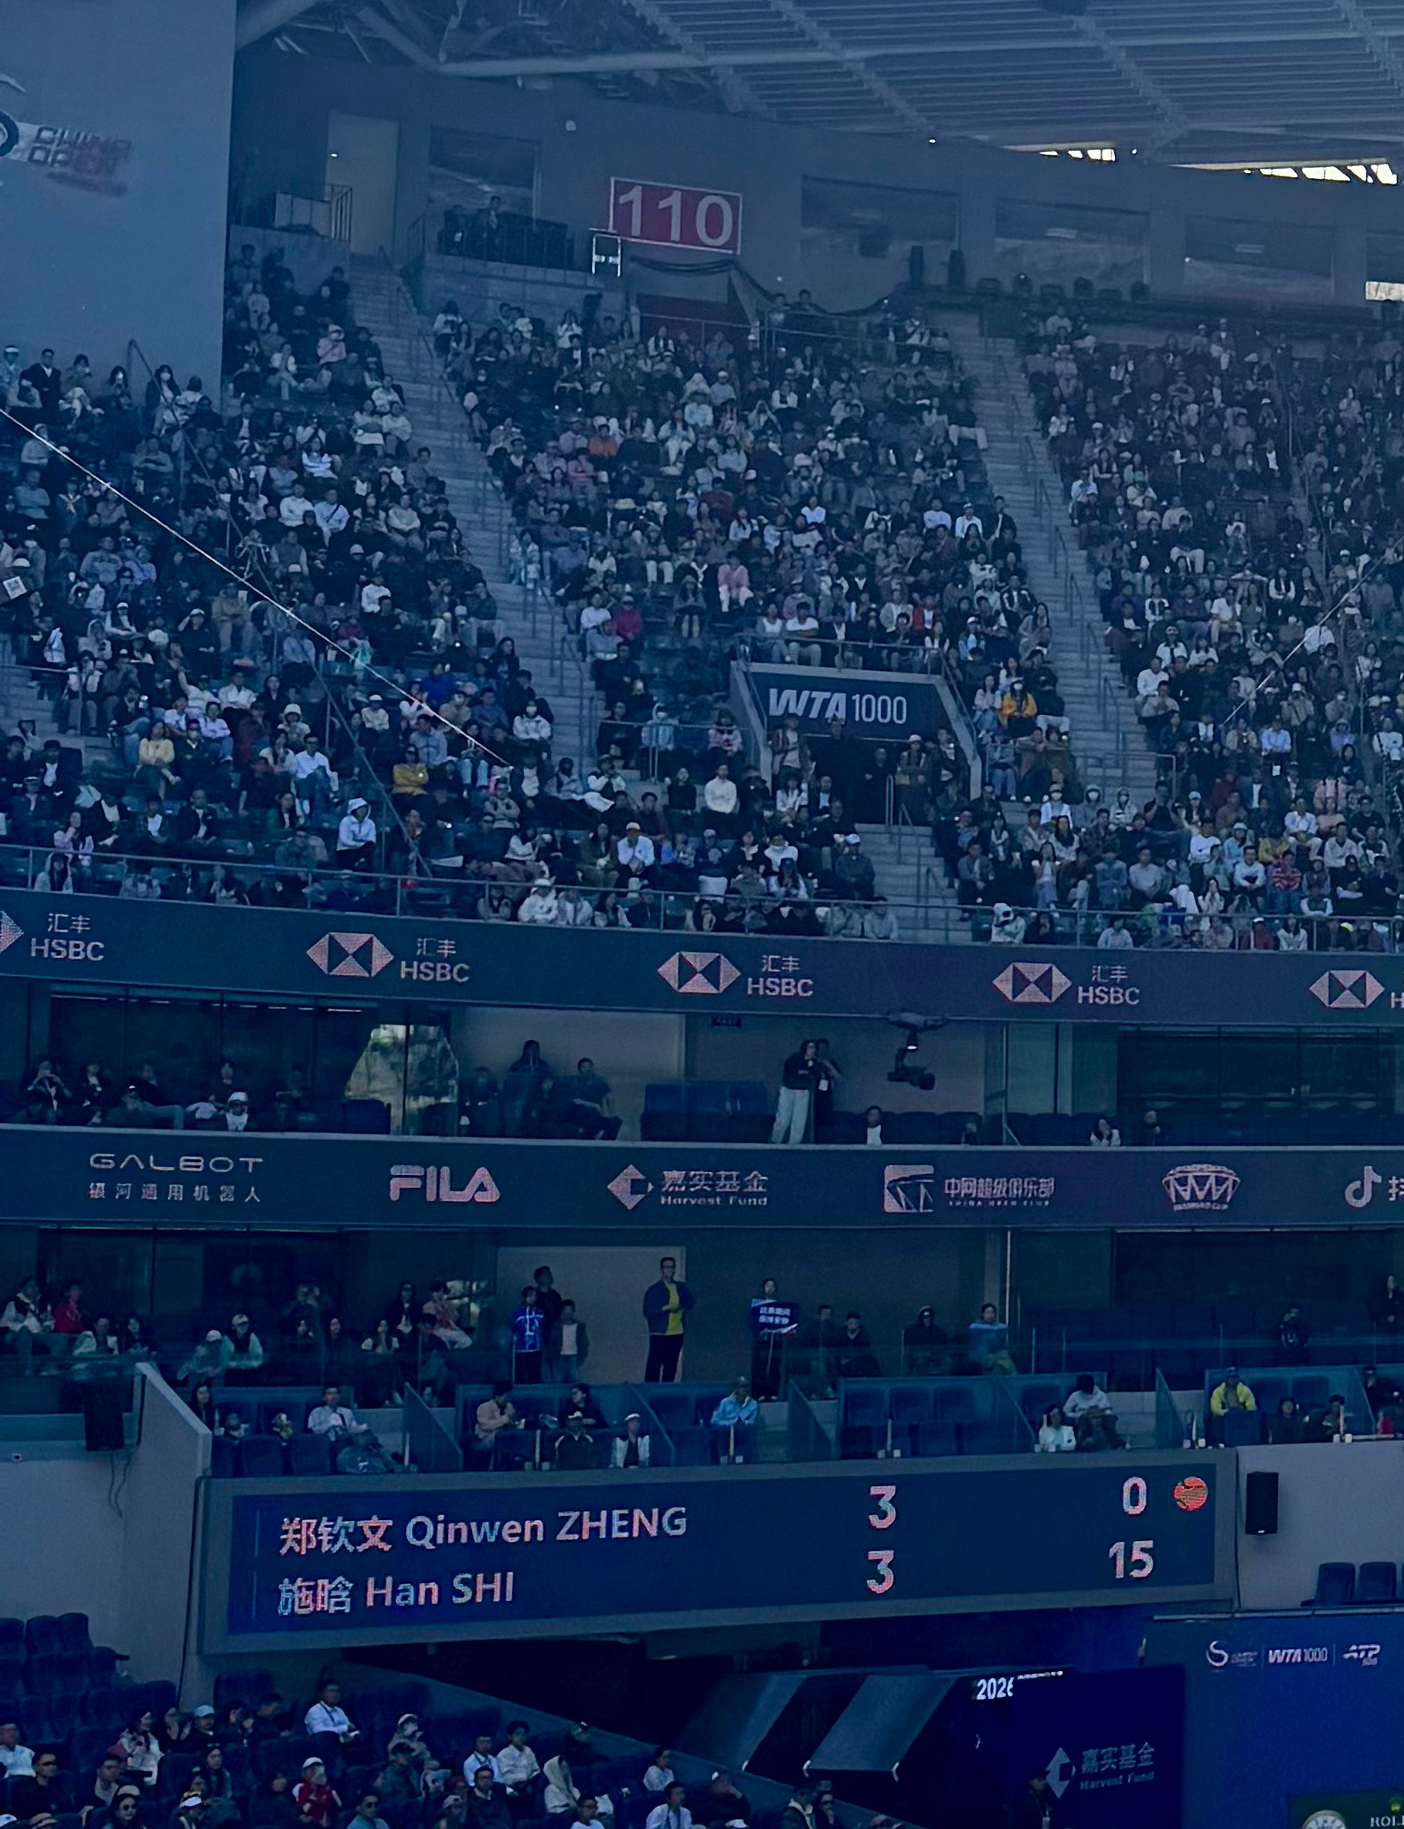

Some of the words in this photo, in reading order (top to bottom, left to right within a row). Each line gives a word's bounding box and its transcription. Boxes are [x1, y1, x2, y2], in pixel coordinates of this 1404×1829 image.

[618, 185, 733, 248] 110
[769, 688, 847, 725] WTA
[852, 693, 907, 724] 1000
[48, 912, 91, 934] 汇丰
[31, 939, 105, 961] HSBC
[416, 938, 457, 958] 汇丰
[400, 961, 470, 984] HSBC
[761, 954, 801, 972] 汇丰
[1091, 964, 1127, 982] 汇丰
[747, 978, 814, 998] HSBC
[1077, 986, 1140, 1005] HSBC
[89, 1153, 263, 1173] GALBOT
[389, 1164, 501, 1203] FILA
[660, 1170, 768, 1194] 嘉实基金
[728, 1194, 768, 1206] Fund
[1122, 1476, 1147, 1515] 0
[868, 1484, 897, 1530] 3
[279, 1514, 393, 1556] 郑钦文
[405, 1514, 544, 1551] Qinwen
[556, 1506, 687, 1542] ZHENG
[1108, 1539, 1154, 1580] 15
[866, 1549, 895, 1594] 3
[278, 1575, 354, 1616] 施晗
[366, 1575, 439, 1608] Han
[451, 1571, 514, 1605] SHI
[1268, 1648, 1301, 1664] WTA
[1303, 1647, 1328, 1663] 1000
[1342, 1644, 1380, 1659] ATP
[1081, 1741, 1155, 1774] 嘉实基金
[1080, 1774, 1123, 1790] Harvest
[1127, 1771, 1155, 1783] Fund
